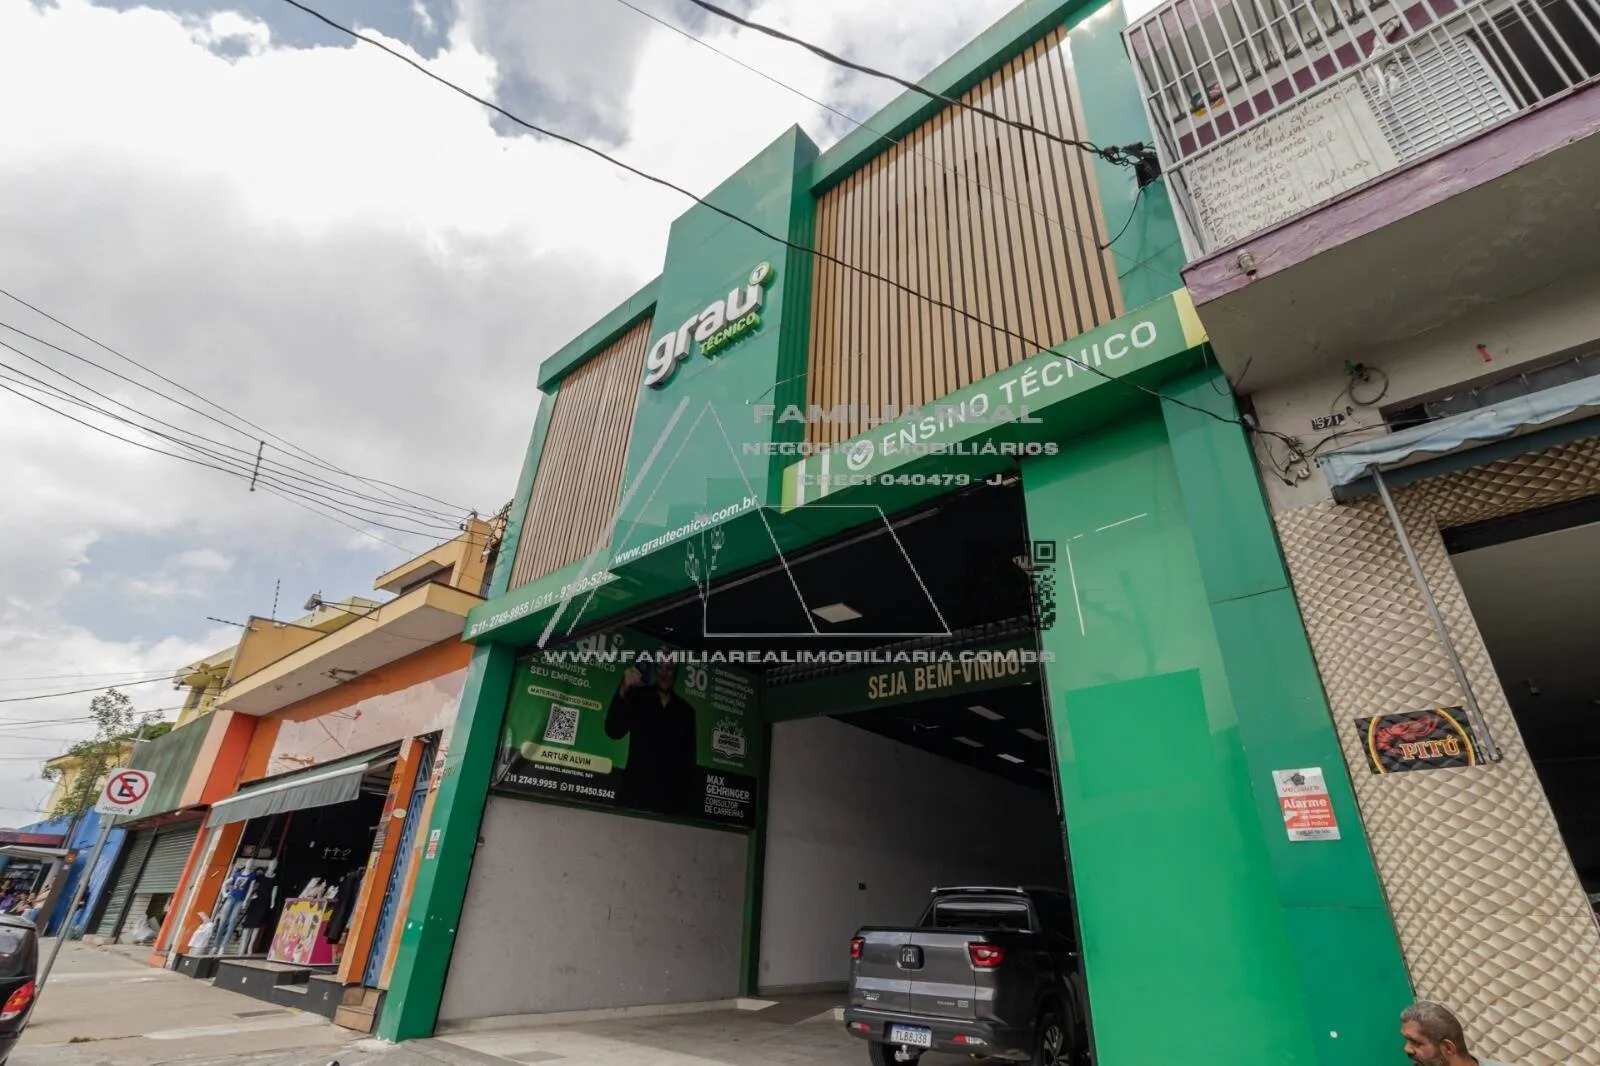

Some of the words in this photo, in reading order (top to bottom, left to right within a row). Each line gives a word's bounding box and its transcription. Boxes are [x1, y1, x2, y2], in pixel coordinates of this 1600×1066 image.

[644, 284, 763, 386] grau
[883, 393, 989, 457] ENSINO
[1000, 320, 1157, 404] TÉCNICO
[684, 665, 708, 691] 30
[868, 671, 908, 700] SEJA
[914, 647, 1027, 692] BEM-VINDO!
[541, 750, 568, 760] ARTUR
[570, 755, 591, 766] ALVIM
[1400, 735, 1460, 760] PITÚ
[706, 773, 725, 786] MAX
[706, 783, 750, 800] GEHRINGER
[1284, 798, 1327, 809] Alarme
